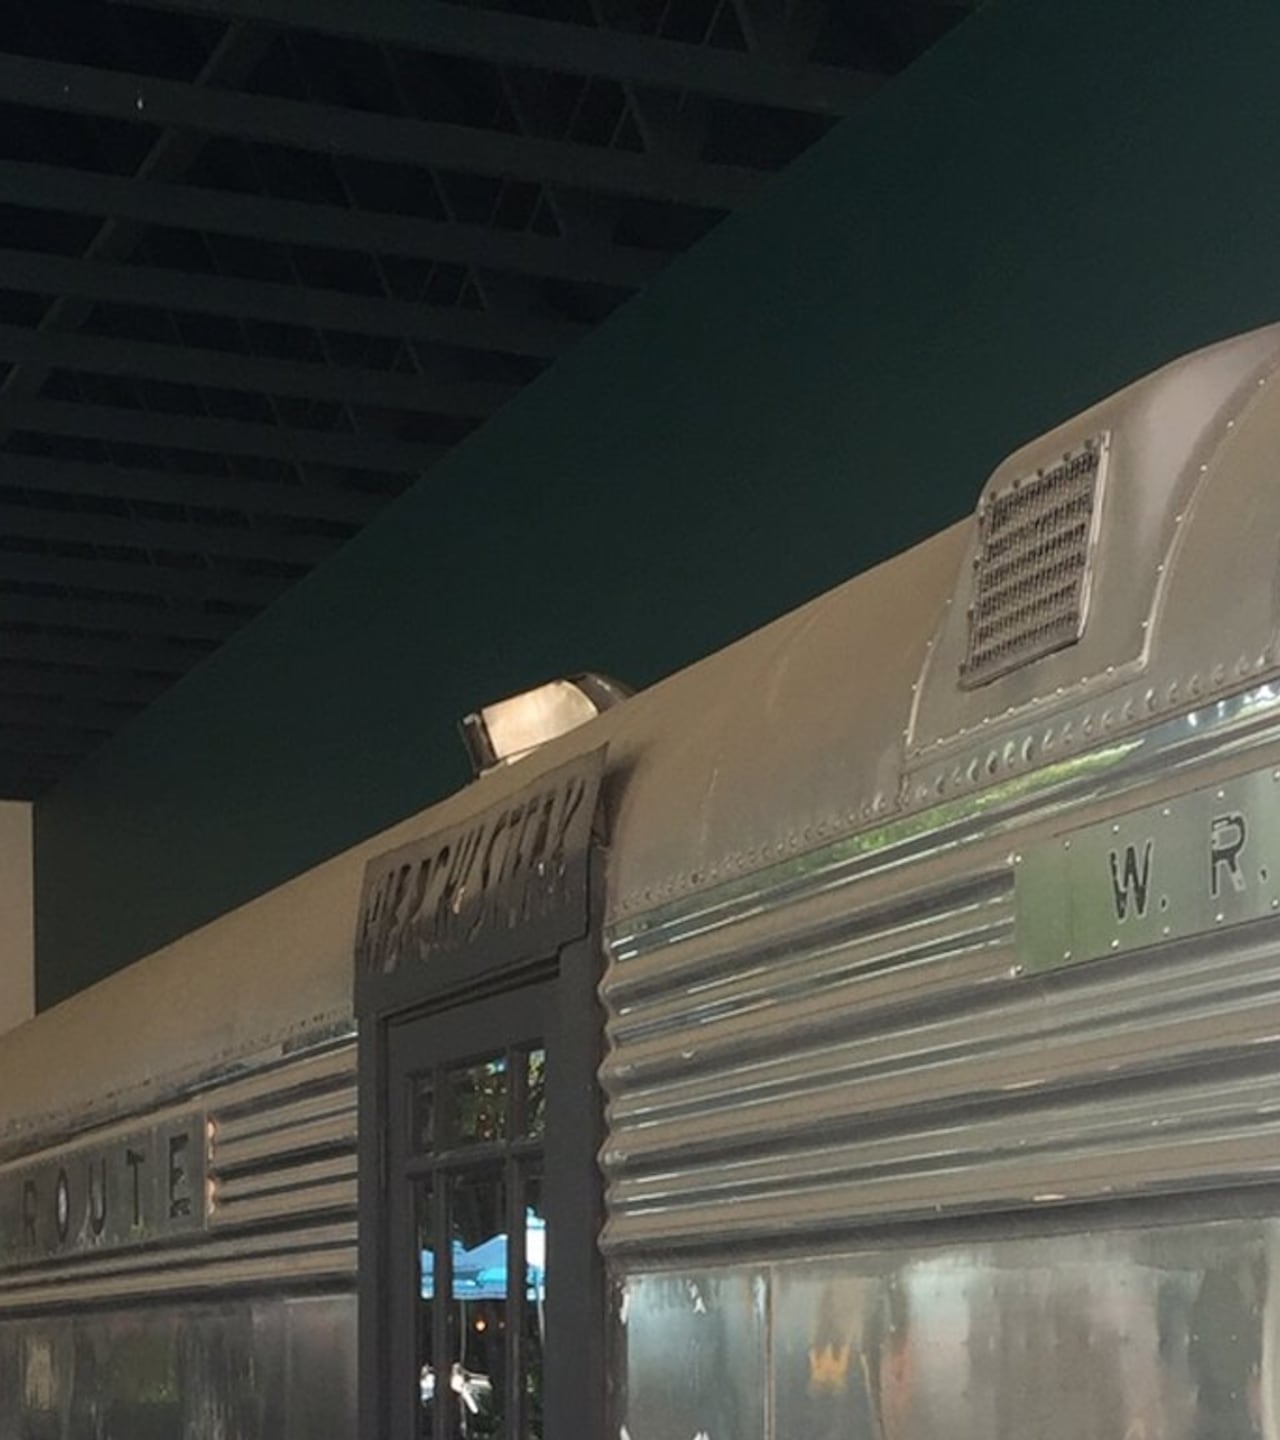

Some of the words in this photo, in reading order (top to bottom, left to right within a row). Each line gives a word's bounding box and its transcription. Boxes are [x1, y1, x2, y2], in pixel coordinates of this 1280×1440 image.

[1109, 840, 1168, 921] W.
[1210, 812, 1269, 896] R.
[23, 1134, 191, 1246] ROUTE
